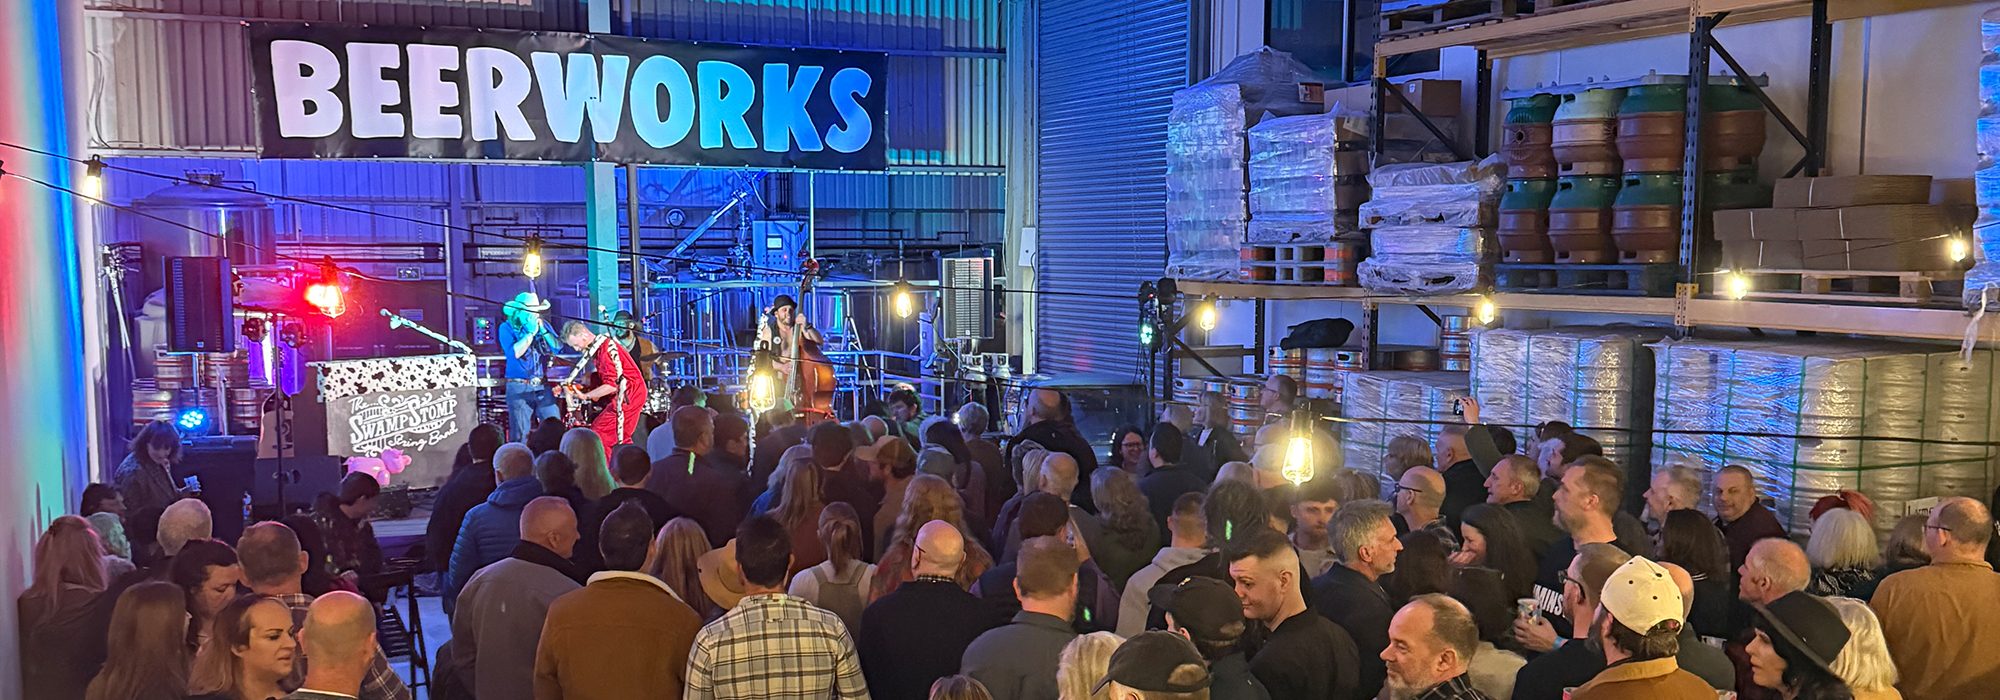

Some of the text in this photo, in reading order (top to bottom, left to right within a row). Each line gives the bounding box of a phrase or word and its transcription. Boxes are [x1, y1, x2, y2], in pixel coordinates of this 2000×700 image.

[269, 39, 874, 153] BEERWORKS
[348, 396, 370, 413] The
[428, 420, 458, 445] Band
[1532, 584, 1565, 618] MINS
